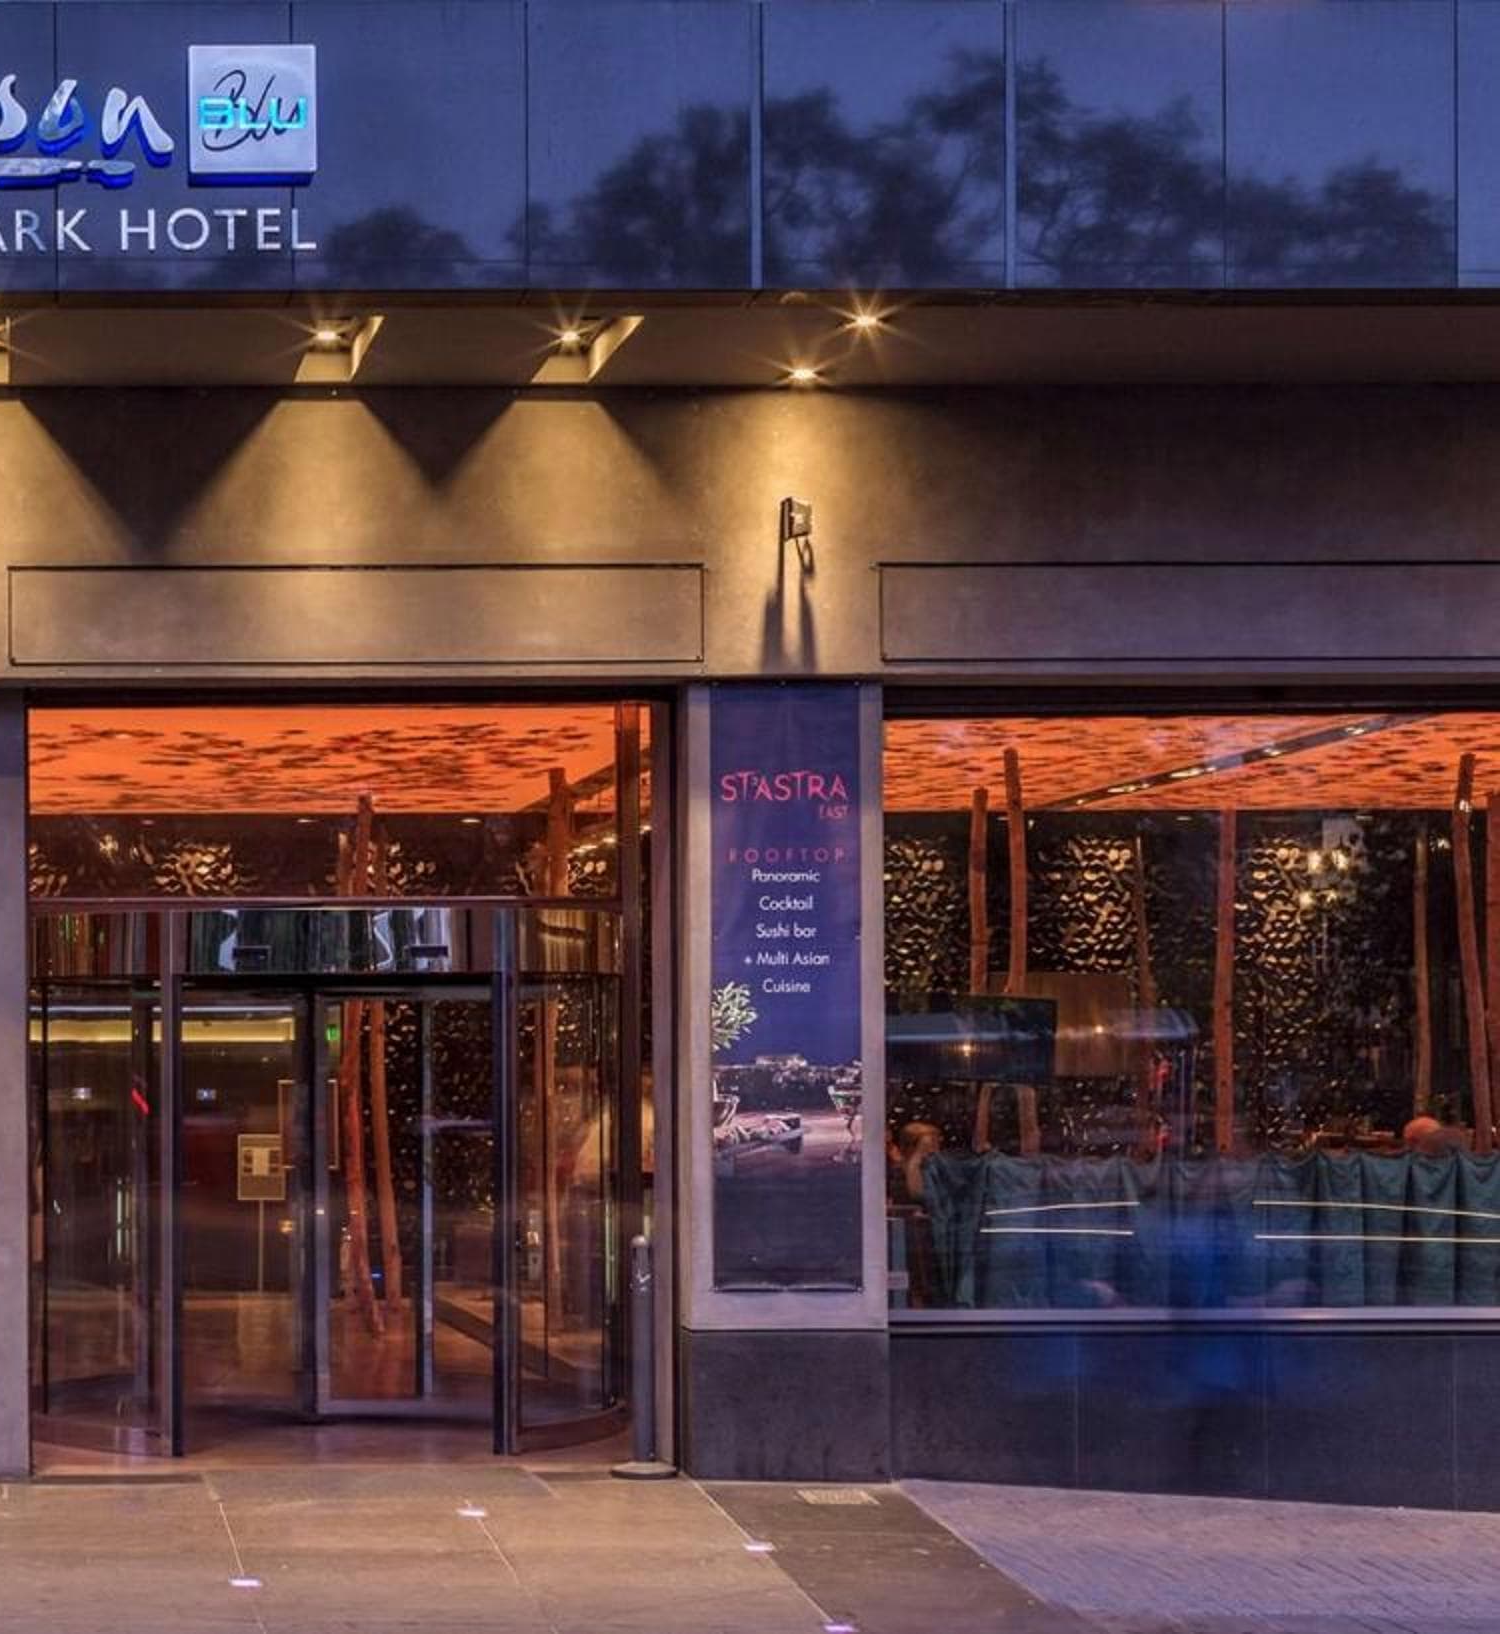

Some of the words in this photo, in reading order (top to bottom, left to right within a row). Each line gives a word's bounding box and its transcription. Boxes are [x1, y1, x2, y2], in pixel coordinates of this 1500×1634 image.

[119, 207, 318, 252] HOTEL
[751, 868, 820, 883] Panoramic
[759, 895, 814, 911] Cocktail
[755, 922, 790, 938] Sushi
[793, 922, 817, 938] bar
[756, 951, 789, 965] Multi
[792, 951, 831, 965] Asian
[763, 977, 811, 993] Cuisine
